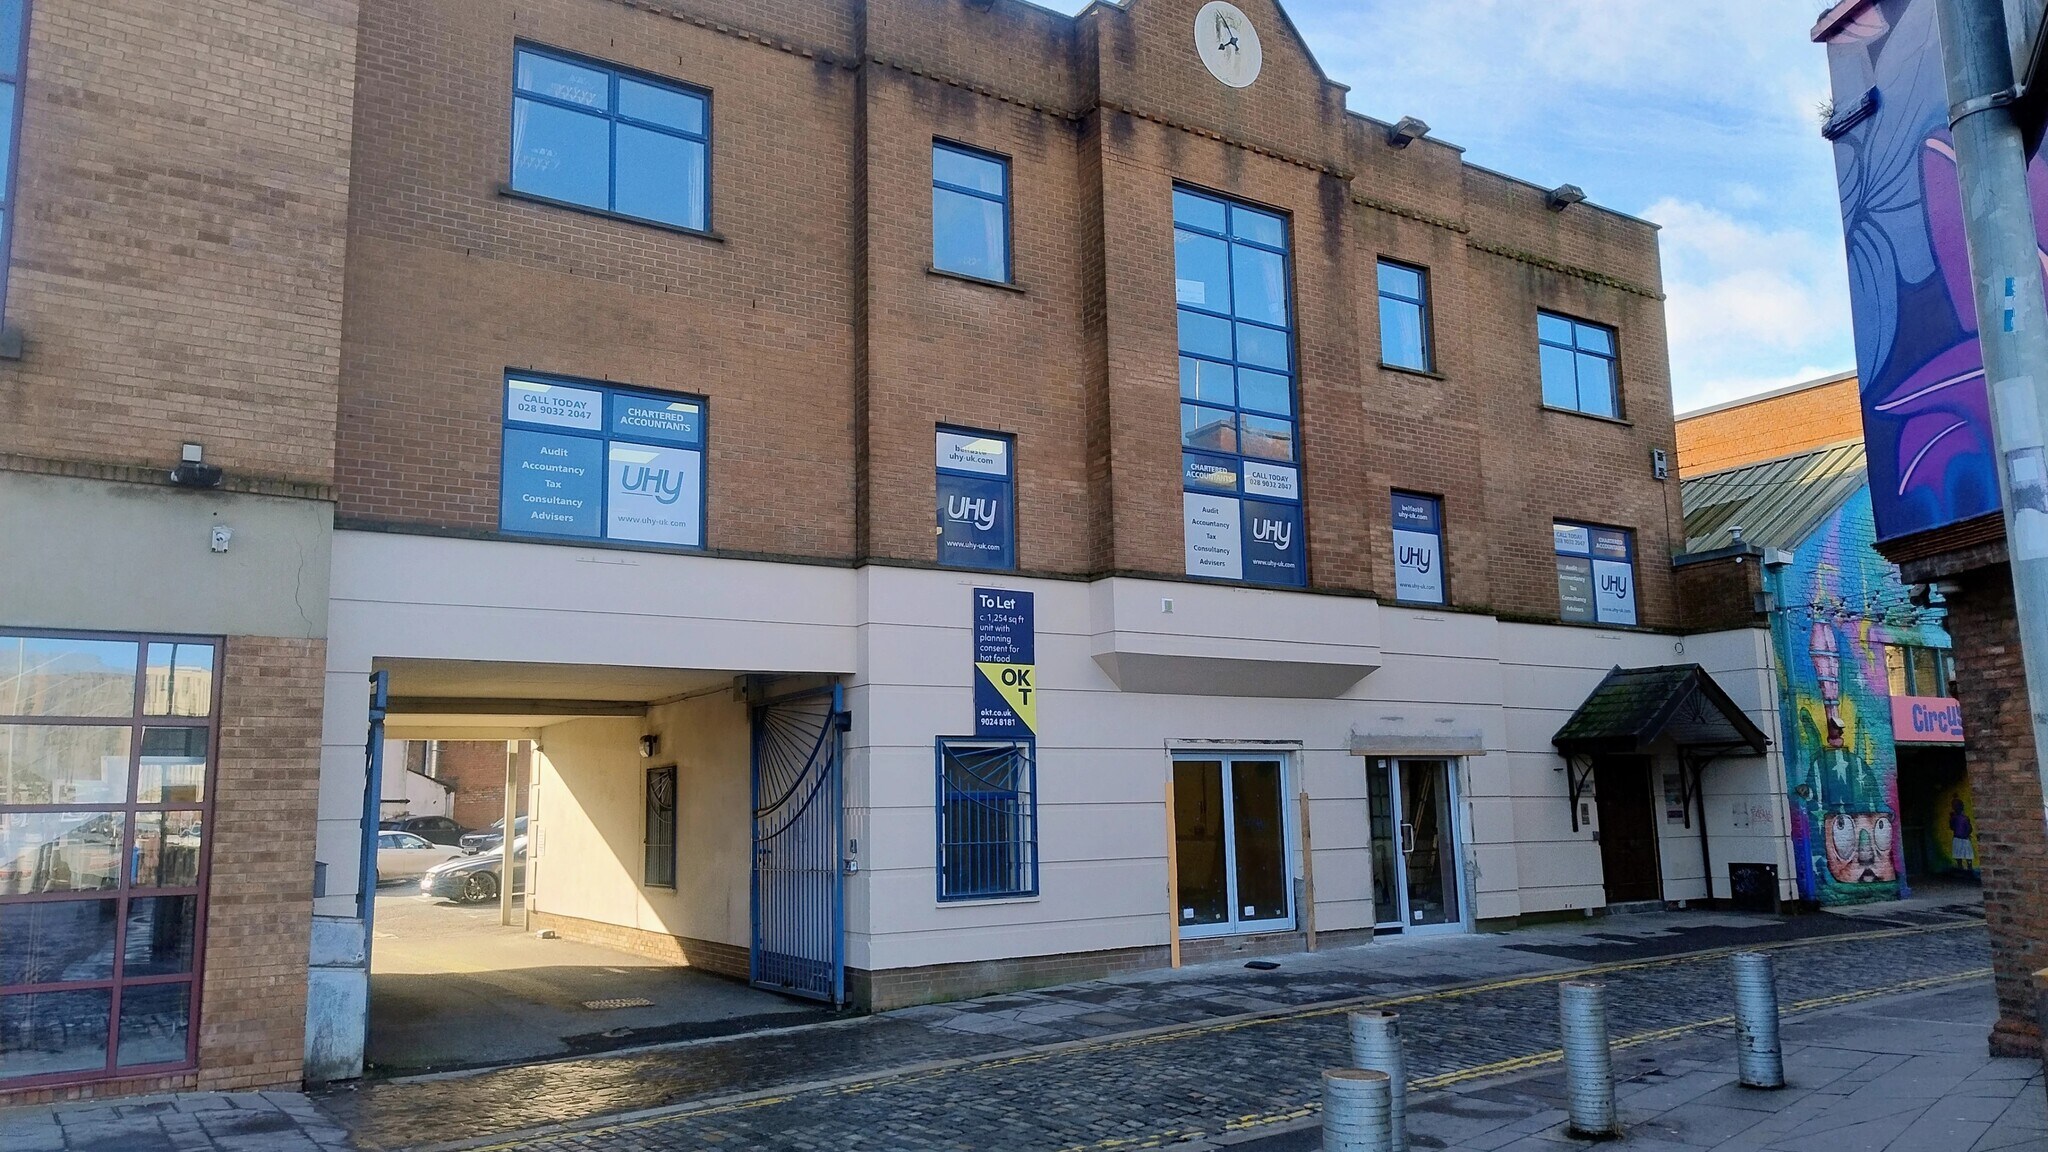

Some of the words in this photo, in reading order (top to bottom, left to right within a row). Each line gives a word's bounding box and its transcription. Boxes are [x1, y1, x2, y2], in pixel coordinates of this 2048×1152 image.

[523, 394, 550, 405] CALL
[552, 397, 587, 410] TODAY
[517, 403, 537, 413] 028
[540, 406, 565, 417] 9032
[567, 409, 592, 420] 2047
[627, 407, 684, 422] CHARTERED
[620, 416, 691, 432] ACCOUNTANTS
[540, 446, 569, 457] Audit
[521, 461, 585, 476] Accountancy
[1190, 463, 1228, 474] CHARTERED
[1252, 471, 1268, 480] CALL
[1269, 473, 1289, 482] TODAY
[544, 479, 562, 489] Tax
[522, 493, 583, 508] Consultancy
[1202, 506, 1219, 514] Audit
[530, 511, 574, 522] Advisers
[1191, 518, 1230, 530] Accountancy
[1206, 532, 1217, 540] Tax
[946, 540, 1001, 551] www.uhy-uk.com
[1193, 544, 1231, 556] Consultancy
[1199, 558, 1226, 567] Advisers
[979, 594, 995, 608] To
[996, 595, 1016, 610] Let
[1008, 616, 1017, 625] sq
[1018, 614, 1025, 623] ft
[979, 623, 994, 631] unit
[994, 624, 1010, 633] with
[979, 633, 1012, 645] planning
[1008, 644, 1020, 653] for
[980, 653, 992, 662] hot
[993, 653, 1011, 663] food
[1001, 668, 1031, 687] OK
[1018, 688, 1032, 706] T
[980, 708, 1012, 717] okt.co.uk
[980, 717, 998, 726] 9024
[999, 718, 1016, 727] 8181
